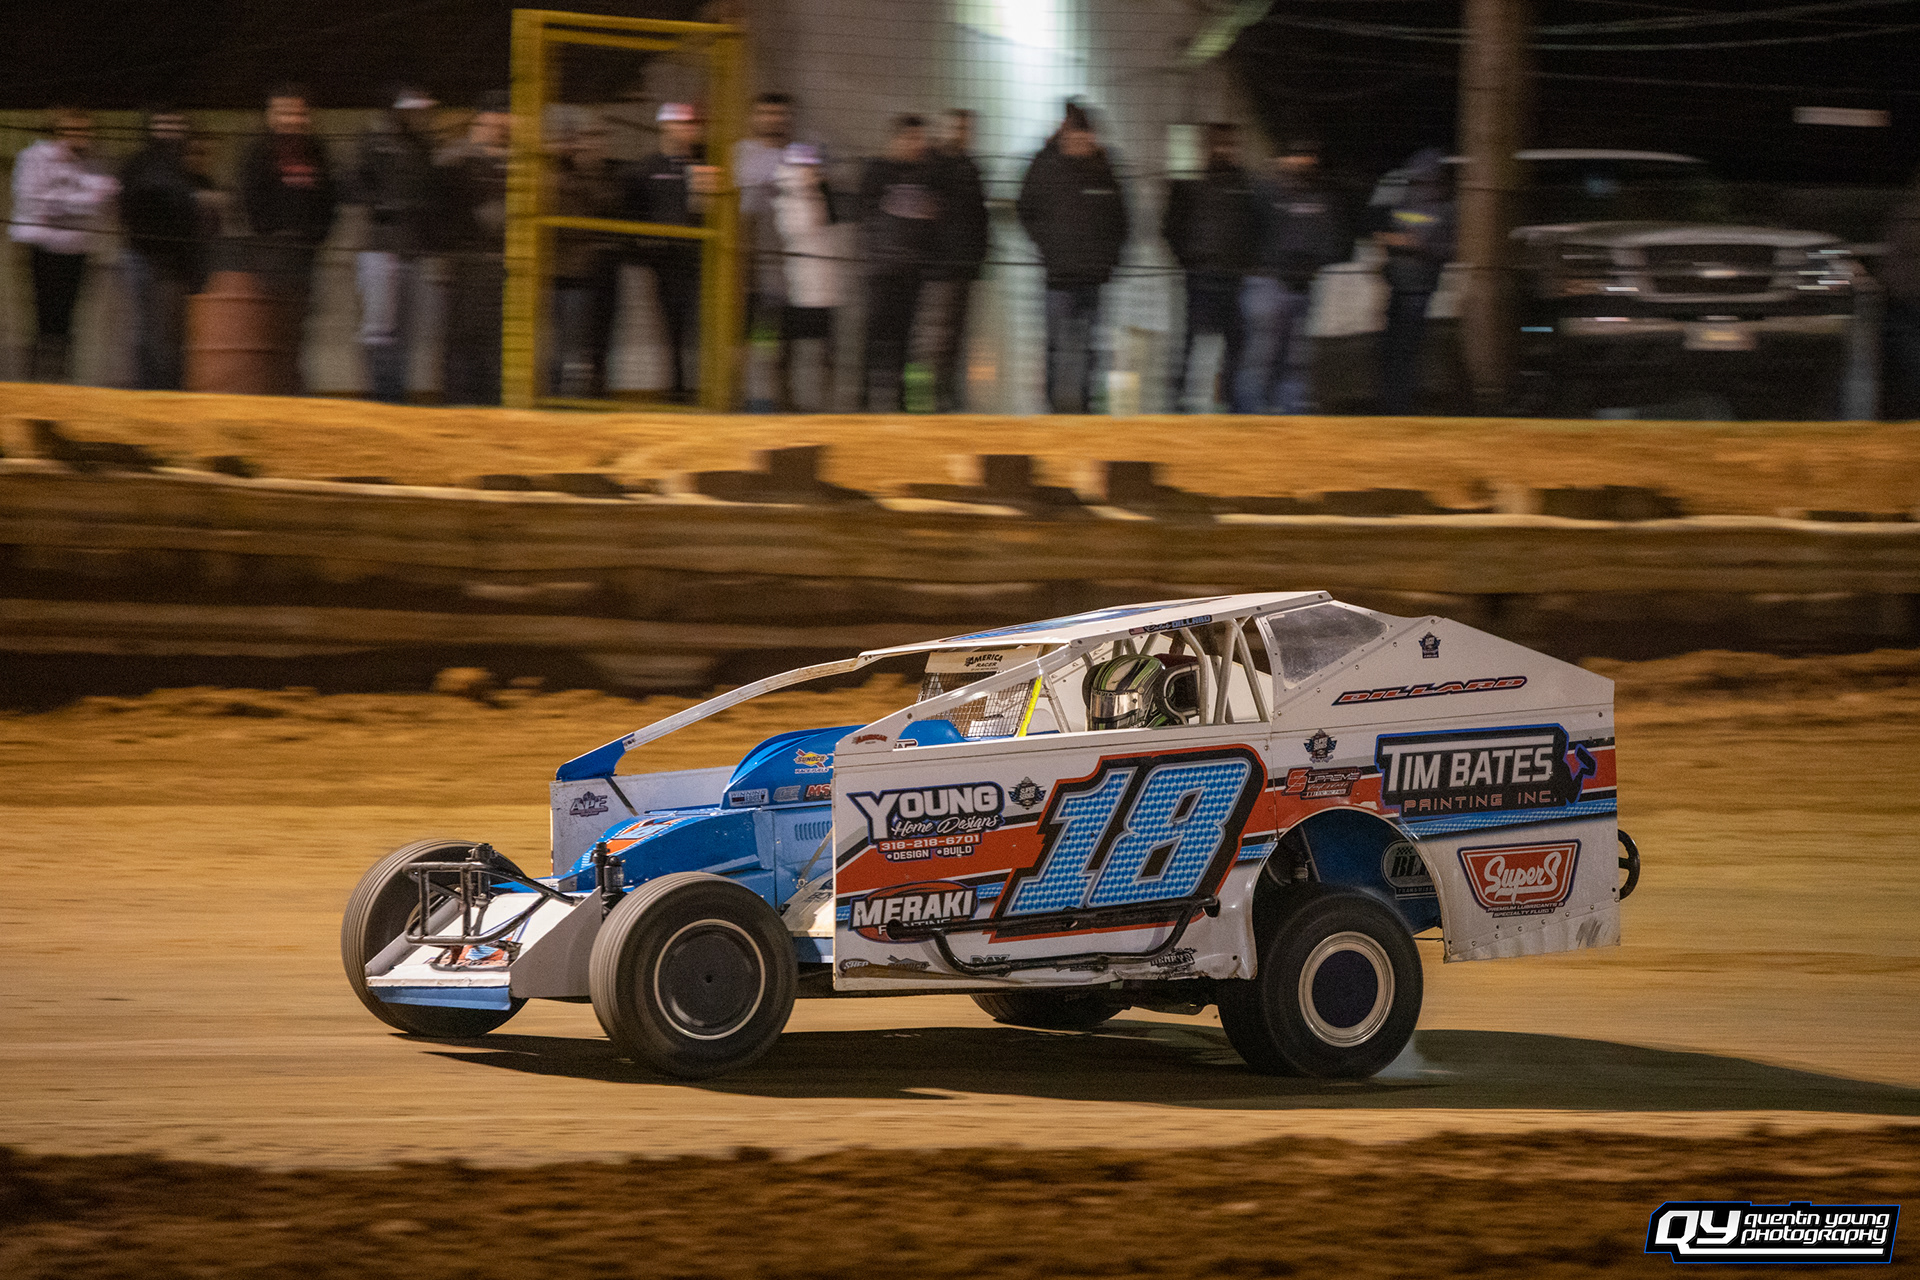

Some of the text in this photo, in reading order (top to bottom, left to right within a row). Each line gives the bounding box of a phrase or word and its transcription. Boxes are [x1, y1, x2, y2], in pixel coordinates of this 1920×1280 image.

[1172, 615, 1211, 628] DILLARD
[1338, 678, 1527, 704] DILLARD
[796, 753, 828, 763] SUNOCO
[1382, 742, 1554, 792] TIM BATES
[855, 785, 1000, 840] YOUNG
[1404, 790, 1557, 813] PAINTING INC.
[891, 814, 999, 837] Home Designs
[1003, 757, 1252, 917] 18
[881, 833, 980, 852] 318-218-6701
[852, 889, 974, 928] MERAKI
[1487, 904, 1517, 912] PREMIUM
[1493, 909, 1529, 917] SPECIALTY
